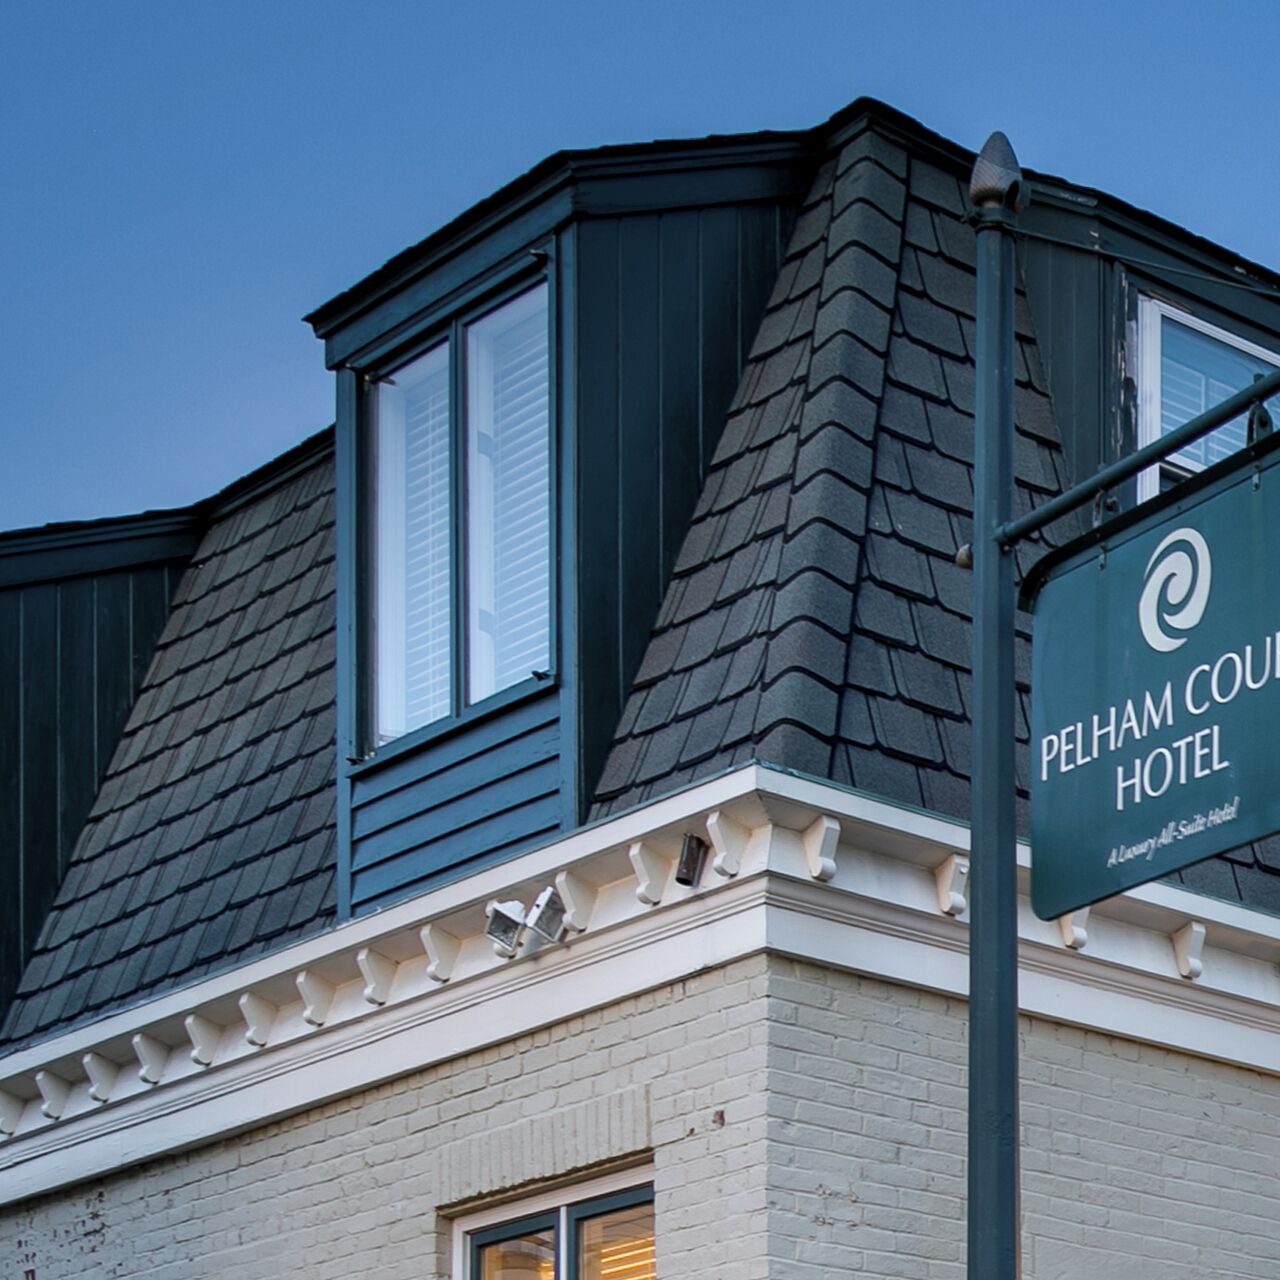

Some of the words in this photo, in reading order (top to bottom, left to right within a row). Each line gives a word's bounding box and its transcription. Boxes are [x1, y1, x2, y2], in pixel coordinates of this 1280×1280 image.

[1040, 681, 1174, 781] PELHAM
[1116, 724, 1230, 811] HOTEL
[1106, 847, 1119, 868] A
[1206, 795, 1241, 828] Hotel
